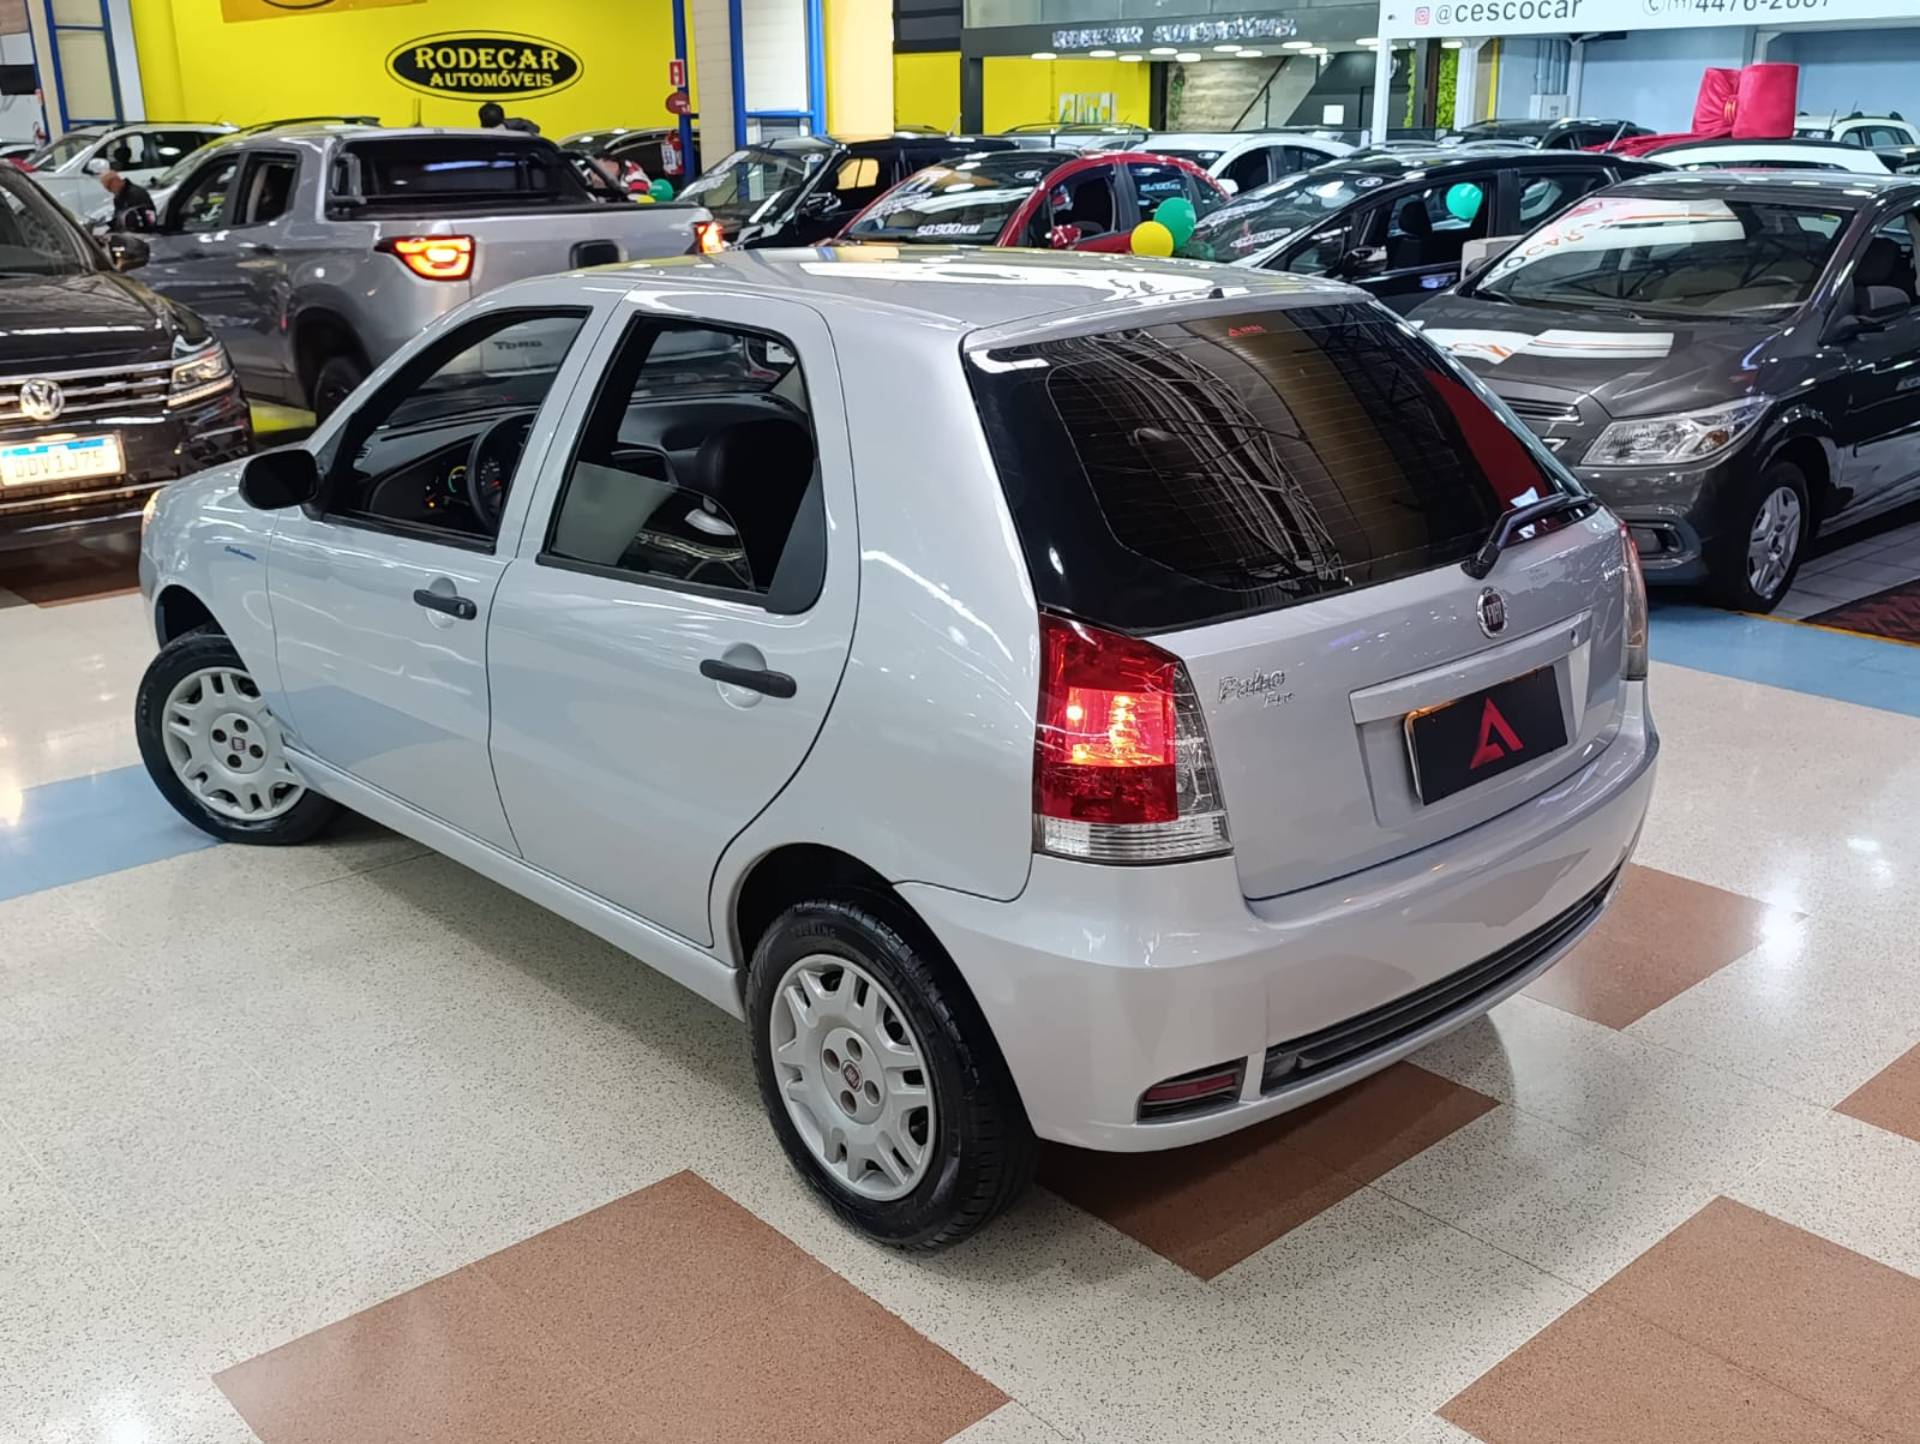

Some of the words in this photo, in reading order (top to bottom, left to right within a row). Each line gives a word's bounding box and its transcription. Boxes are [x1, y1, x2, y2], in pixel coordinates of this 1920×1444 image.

[1435, 0, 1583, 25] @cescocar
[415, 47, 560, 71] RODECAR
[430, 70, 554, 88] AUTOMÓVEIS
